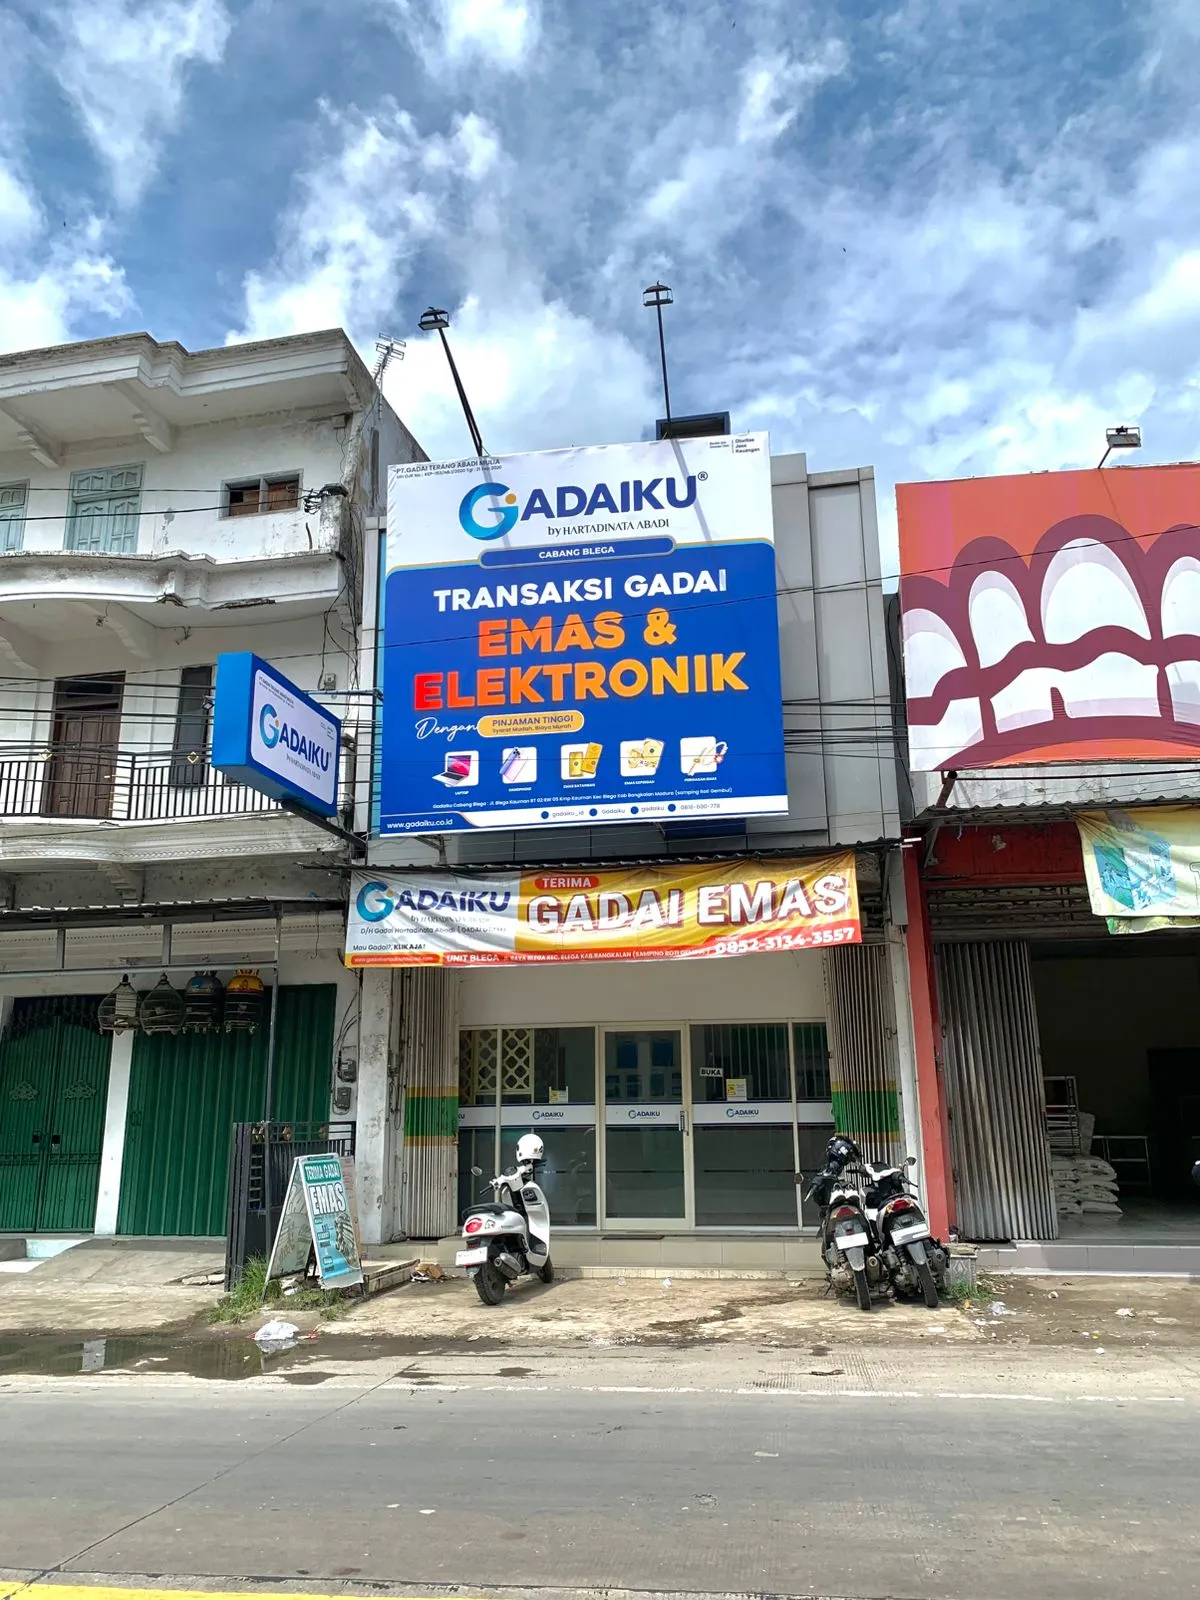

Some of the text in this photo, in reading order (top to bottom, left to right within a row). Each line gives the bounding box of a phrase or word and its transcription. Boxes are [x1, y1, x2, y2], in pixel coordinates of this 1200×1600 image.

[429, 462, 456, 471] TERANG
[457, 460, 478, 468] ABADI
[459, 475, 697, 541] GADAIKU
[548, 518, 670, 538] by HARTADINATA ABADI
[539, 546, 615, 559] CABANG BLEGA
[433, 568, 727, 613] TRANSAKSI GADAI
[477, 607, 677, 658] EMAS &
[413, 651, 750, 711] ELEKTRONIK
[415, 716, 478, 742] Dengan
[492, 714, 574, 727] PINJAMAN TINGGI
[260, 704, 329, 772] GADAIKU
[387, 818, 453, 830] www.gadaiku.co.id
[542, 877, 592, 889] TERIMA
[356, 881, 511, 922] GADAIKU
[527, 873, 851, 933] GADAI EMAS
[360, 926, 373, 935] D/H
[446, 954, 468, 962] UNIT
[469, 953, 499, 962] BLEGA
[701, 1068, 721, 1076] BUKA
[308, 1182, 347, 1216] EMAS
